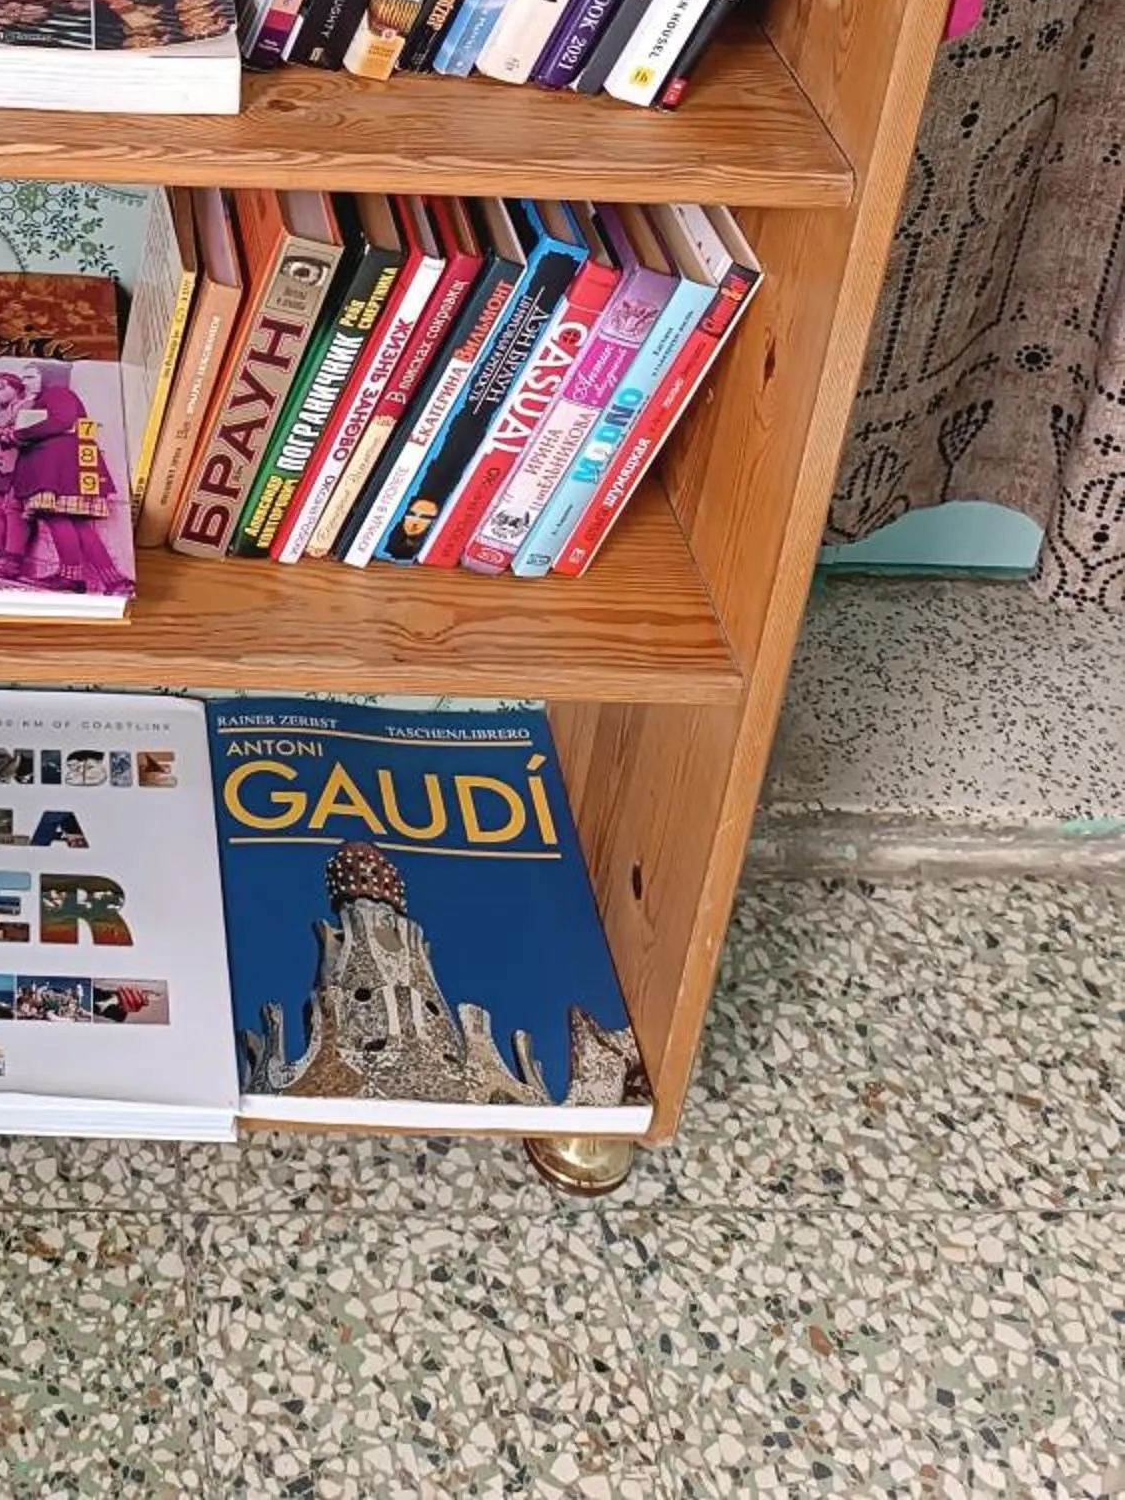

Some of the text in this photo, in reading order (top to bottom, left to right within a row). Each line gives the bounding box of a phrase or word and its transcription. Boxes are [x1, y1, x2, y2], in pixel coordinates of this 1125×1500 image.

[556, 33, 588, 73] 2021
[647, 10, 682, 61] HOUSEL
[329, 315, 414, 464] ЖИЗНЬ ЗАНОВО
[384, 275, 469, 408] В поисках сокровищ
[406, 275, 513, 449] ЕКАТЕРИНА ВИЛЬМОНТ
[484, 305, 548, 407] ДЭН БРАУН
[178, 307, 306, 553] БРАУН
[275, 325, 364, 478] ПОГРАНИЧНИК
[484, 311, 591, 469] CASUAL
[523, 423, 563, 478] ИРИНА
[81, 721, 172, 731] COASTLINE
[217, 715, 337, 730] RAINER ZERBST
[226, 739, 324, 757] ANTONI
[224, 754, 558, 845] GAUDÍ
